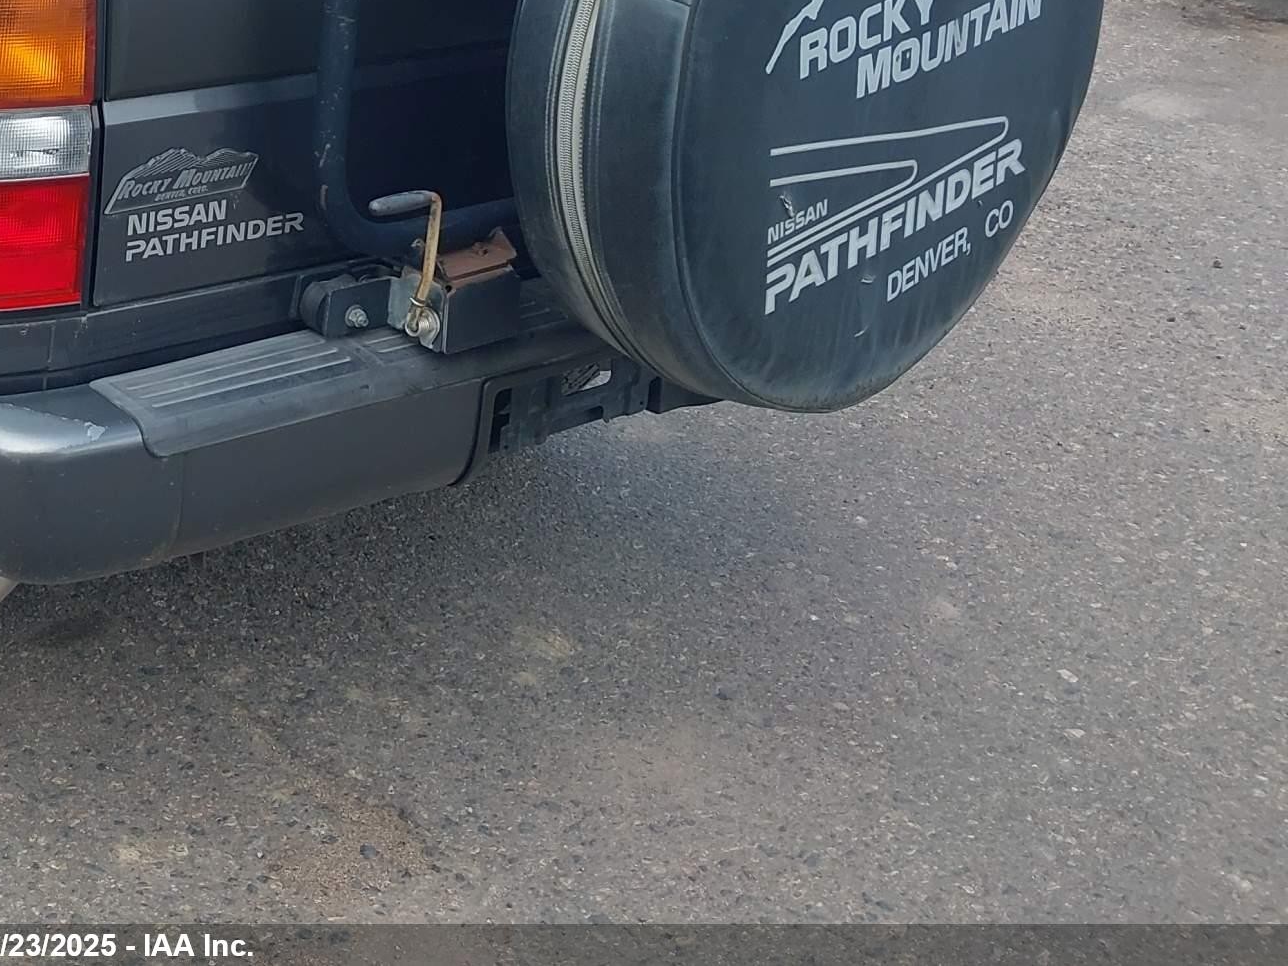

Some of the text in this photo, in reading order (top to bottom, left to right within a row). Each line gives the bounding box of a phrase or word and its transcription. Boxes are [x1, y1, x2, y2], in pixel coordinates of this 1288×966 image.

[117, 177, 172, 200] ROCKY
[125, 212, 305, 262] PATHFINDER
[127, 199, 227, 236] NISSAN
[764, 138, 1026, 316] PATHFINDER
[767, 198, 829, 245] NISSAN
[886, 199, 1014, 303] DENVER, CO
